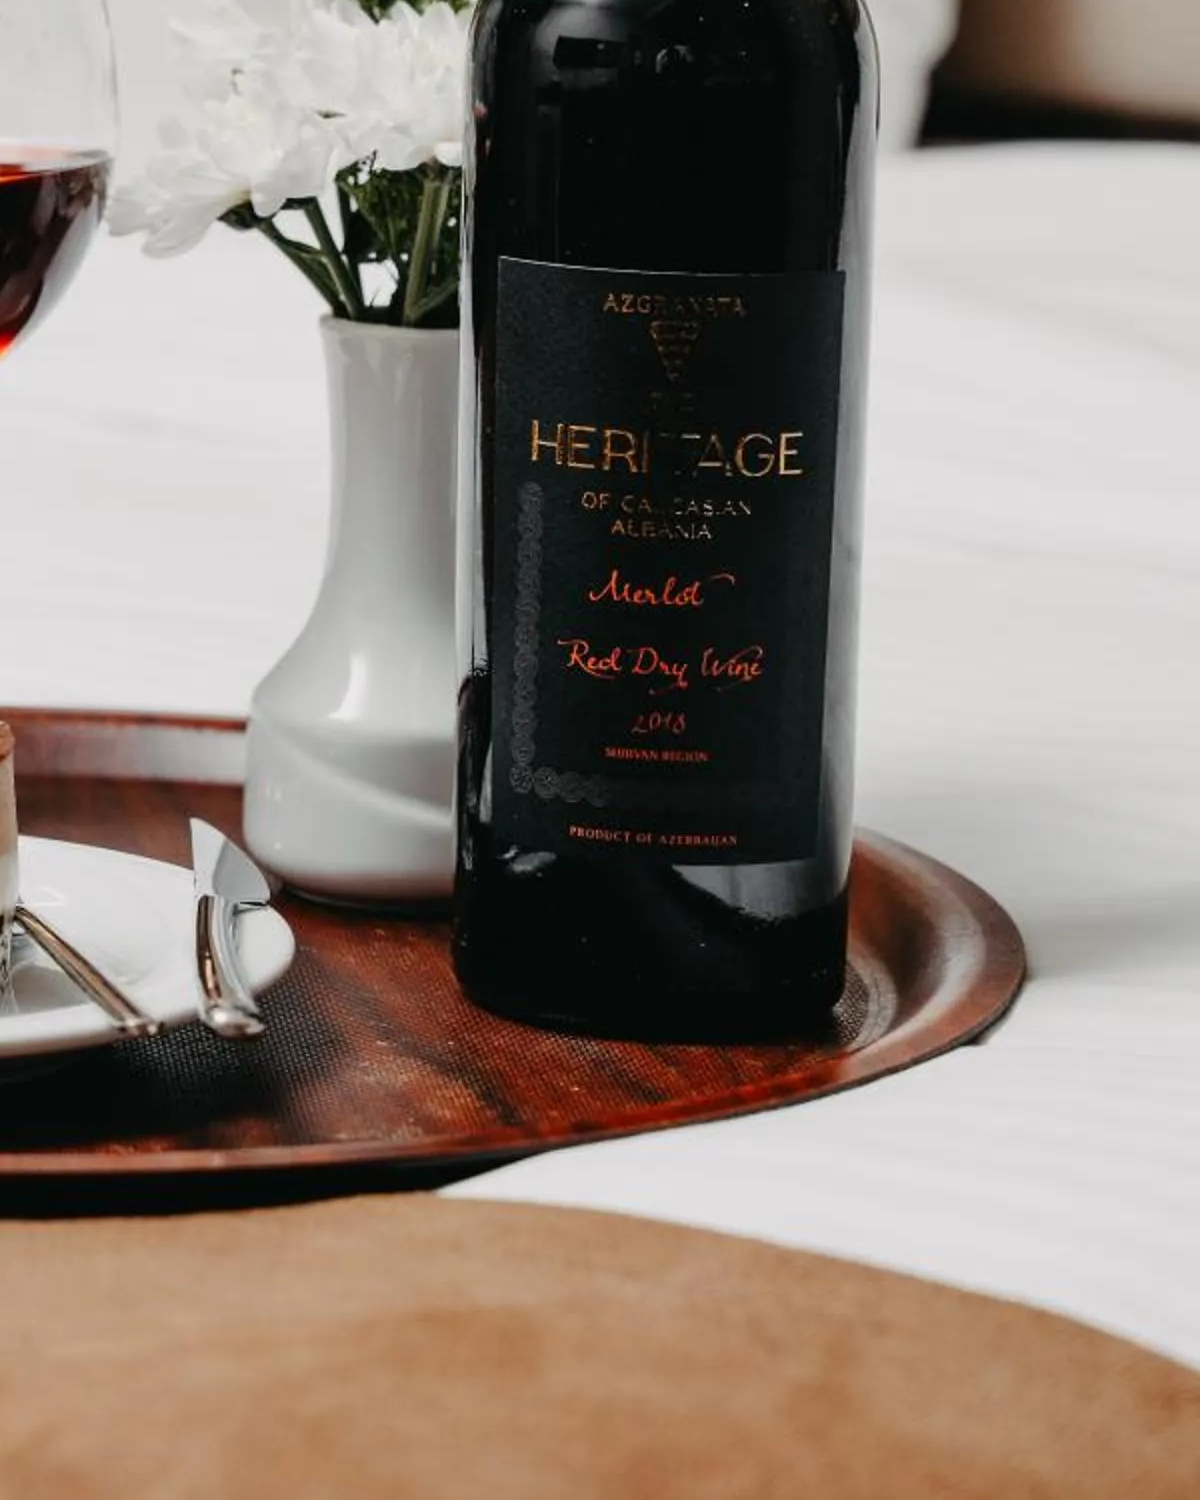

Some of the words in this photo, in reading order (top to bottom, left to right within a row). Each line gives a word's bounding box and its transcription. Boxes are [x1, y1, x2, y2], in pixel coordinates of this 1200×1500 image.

[581, 490, 612, 510] OF
[620, 494, 752, 517] CACASAN
[588, 569, 736, 607] Merlot
[557, 638, 622, 680] Red
[631, 646, 689, 695] Dry
[701, 644, 765, 693] Wine
[568, 825, 630, 844] PRODUCT
[635, 832, 652, 845] OF
